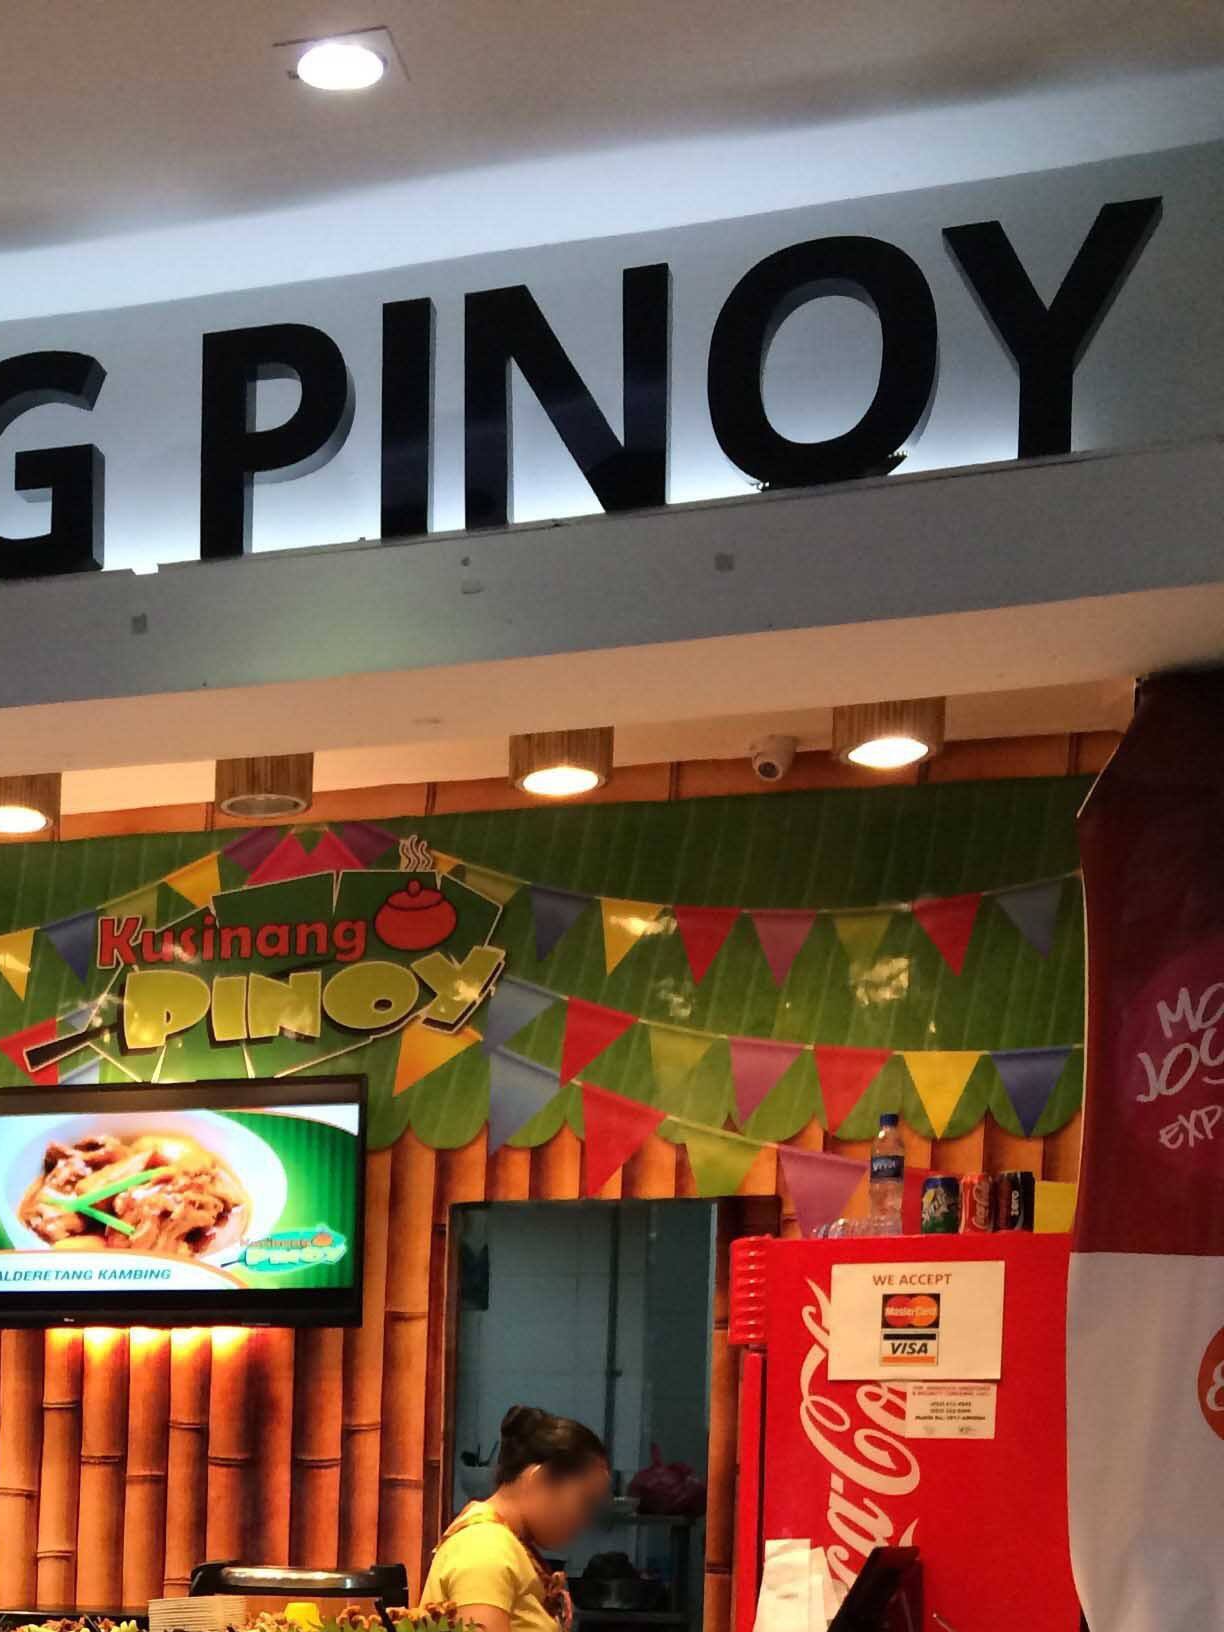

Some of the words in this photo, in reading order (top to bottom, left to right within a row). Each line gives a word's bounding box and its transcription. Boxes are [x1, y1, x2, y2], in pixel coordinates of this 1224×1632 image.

[199, 196, 1164, 560] PINOY
[97, 915, 368, 969] Kusinang
[122, 944, 507, 1051] PINOY
[97, 1268, 172, 1281] KAMBING
[872, 1274, 895, 1287] WE
[898, 1273, 953, 1286] ACCEPT
[890, 1342, 929, 1355] VISA
